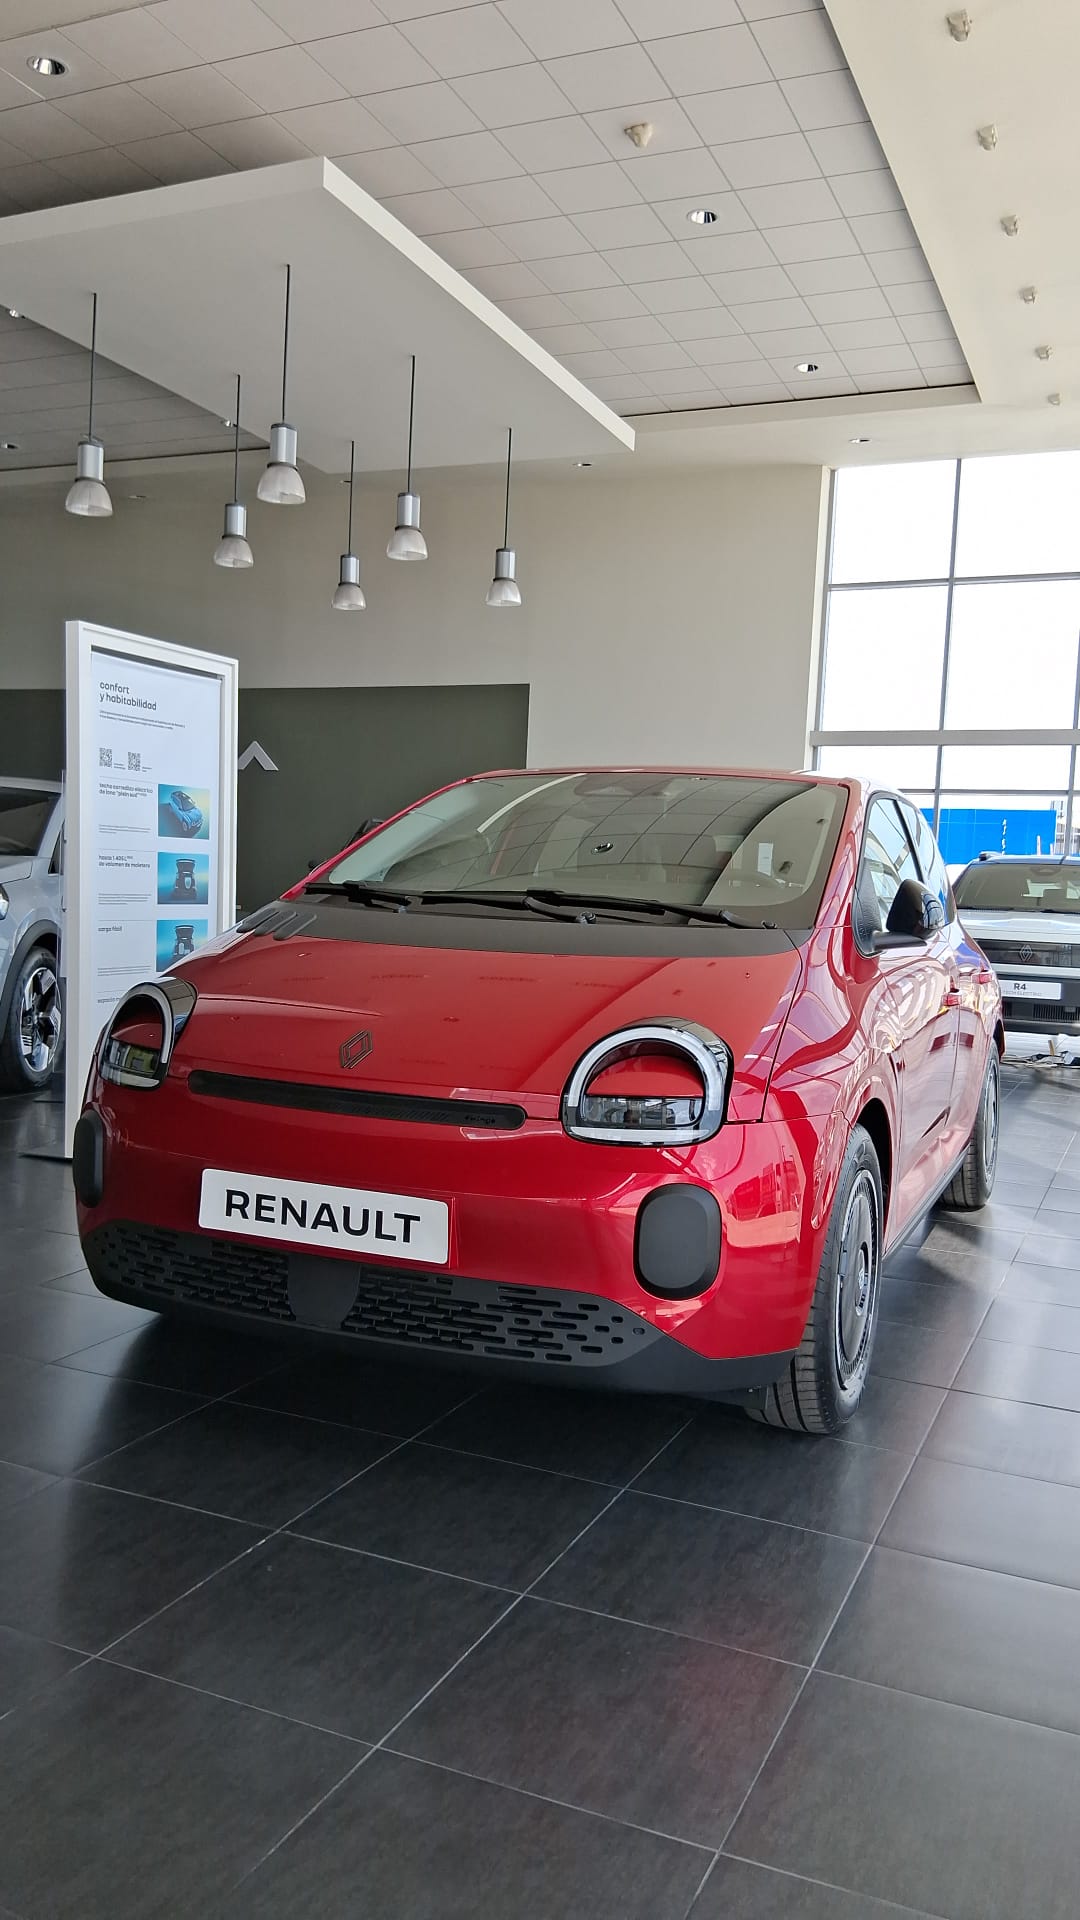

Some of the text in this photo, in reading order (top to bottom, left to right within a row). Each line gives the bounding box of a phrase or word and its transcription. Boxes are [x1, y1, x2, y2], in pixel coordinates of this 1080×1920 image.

[100, 682, 129, 694] confort
[100, 693, 157, 710] y habitabilidad
[225, 1189, 421, 1243] RENAULT
